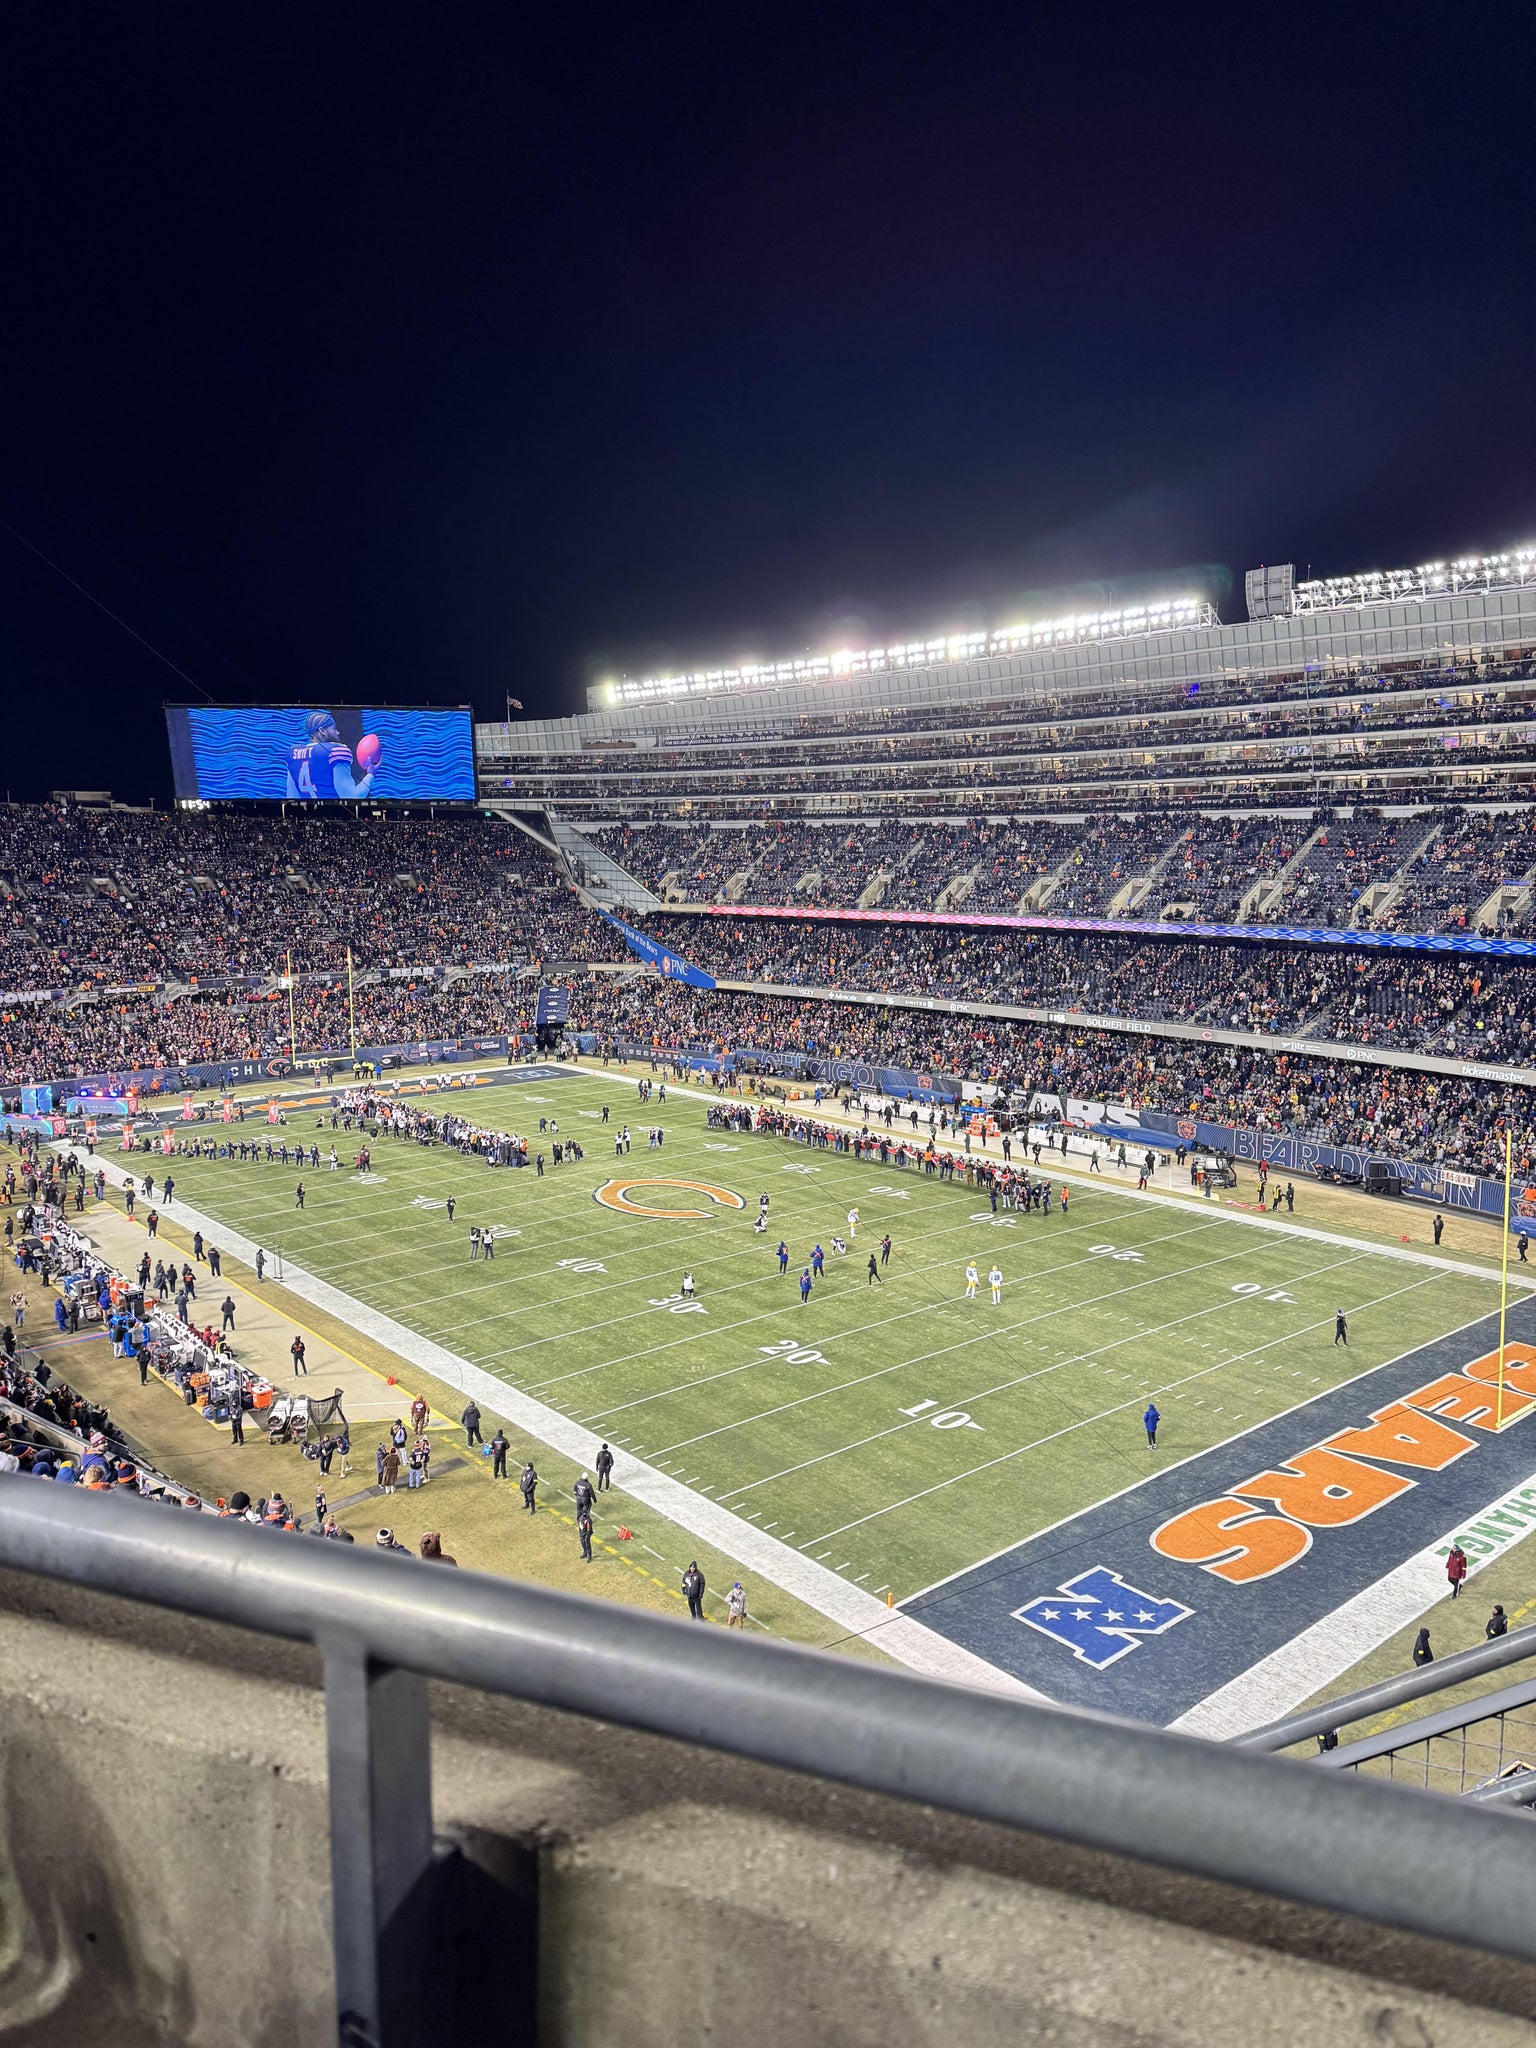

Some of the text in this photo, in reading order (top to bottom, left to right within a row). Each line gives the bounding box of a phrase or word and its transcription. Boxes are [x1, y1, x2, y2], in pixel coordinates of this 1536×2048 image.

[292, 747, 314, 759] SWIFT
[299, 761, 317, 798] 4
[646, 941, 658, 956] Bears
[389, 967, 436, 977] BEAR
[671, 959, 688, 976] PNC
[1087, 1018, 1151, 1033] SOLDIER FIELD
[1357, 1051, 1377, 1062] PNC
[1461, 1064, 1526, 1083] ticketmaster
[1236, 1129, 1321, 1173] BEAR
[868, 1186, 912, 1201] 40
[968, 1213, 1018, 1229] 30
[1087, 1244, 1146, 1263] 20
[556, 1257, 604, 1273] 40
[1231, 1282, 1298, 1304] 10
[648, 1293, 704, 1314] 30
[758, 1339, 823, 1365] 20
[897, 1398, 972, 1430] 10
